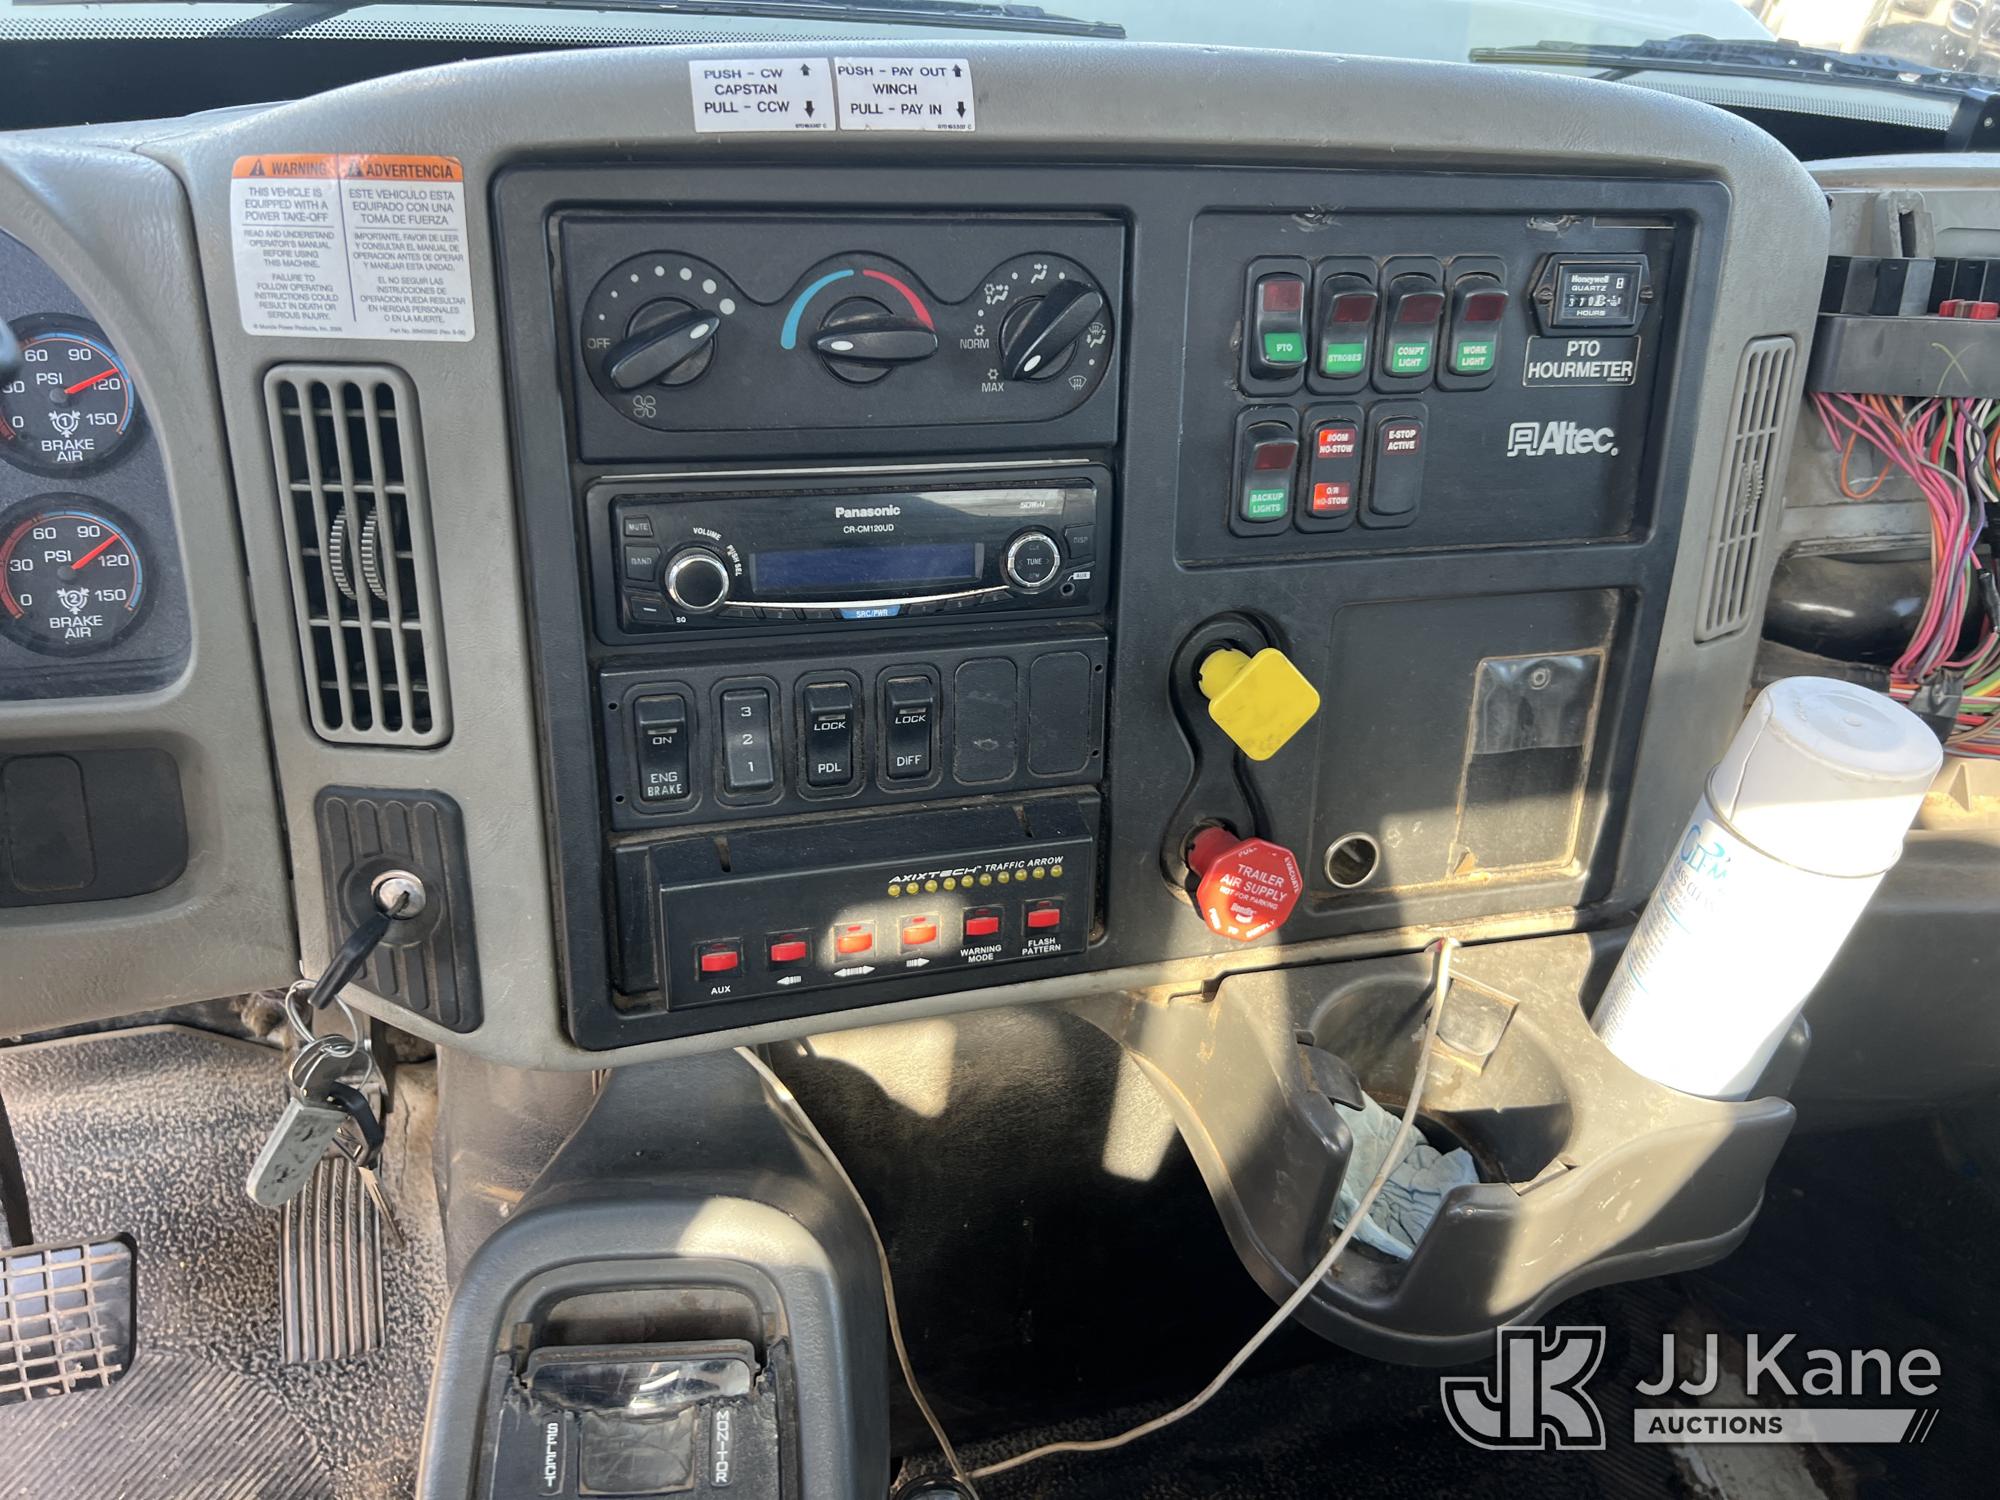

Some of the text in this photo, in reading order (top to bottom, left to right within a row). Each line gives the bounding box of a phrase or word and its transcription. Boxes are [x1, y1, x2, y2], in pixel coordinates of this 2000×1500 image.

[704, 69, 783, 79] PUSH CW
[838, 66, 947, 77] PUSH PAY OUT
[715, 84, 777, 95] CAPSTAN
[873, 84, 917, 94] WINCH
[704, 102, 790, 113] PULL CCW
[851, 104, 942, 114] PULL PAY IN
[272, 161, 327, 175] WARNING
[367, 164, 453, 178] ADVERTENCIA
[249, 187, 322, 197] THIS VEHICLE IS
[349, 189, 455, 200] ESTE VEHICULO ESTA
[245, 200, 328, 210] EQUIPPED WITH A
[353, 201, 454, 213] EQUIPADO CON UNA
[246, 211, 328, 222] POWER TAKE-OFF
[361, 213, 448, 225] TOMA DE FUERZA
[283, 231, 334, 239] UNDERSTAND
[264, 259, 281, 267] THIS
[304, 274, 315, 282] TO
[1572, 275, 1609, 284] Honeywell
[256, 282, 288, 290] FOLLOW
[587, 337, 611, 350] OFF
[960, 337, 990, 351] NORM
[1277, 343, 1293, 352] PTO
[1463, 345, 1487, 354] WORK
[1567, 340, 1600, 357] PTO
[25, 350, 48, 362] 60
[69, 349, 91, 361] 90
[1398, 347, 1424, 356] COMPT
[1398, 358, 1422, 367] LIGHT
[1462, 357, 1485, 366] LIGHT
[1528, 361, 1632, 379] HOURMETER
[37, 372, 63, 385] PSI
[981, 382, 1005, 393] MAX
[12, 416, 24, 429] 0
[86, 413, 118, 426] 150
[1327, 434, 1348, 442] BOOM
[1389, 430, 1416, 440] E-STOP
[42, 439, 94, 451] BRAKE
[1320, 444, 1353, 453] NO-STOW
[1388, 440, 1414, 450] ACTIVE
[57, 450, 83, 462] AIR
[1252, 492, 1283, 502] BACKUP
[835, 505, 901, 518] Panasonic
[1253, 503, 1280, 513] LIGHTS
[77, 526, 100, 538] 90
[629, 523, 648, 531] MUTE
[843, 523, 894, 534] CR-CM120UD
[33, 528, 56, 540] 60
[693, 527, 722, 540] VOLUME
[44, 550, 71, 563] PSI
[98, 554, 129, 567] 120
[10, 559, 33, 572] 30
[20, 594, 32, 606] 0
[95, 589, 127, 601] 150
[50, 615, 103, 628] BRAKE
[65, 627, 91, 639] AIR
[740, 706, 752, 718] 3
[894, 713, 926, 725] LOCK
[813, 720, 846, 732] LOCK
[653, 735, 673, 745] ON
[742, 734, 753, 745] 2
[747, 761, 755, 772] 1
[896, 755, 922, 767] DIFF
[817, 762, 842, 774] PDL
[651, 772, 678, 783] ENG
[647, 783, 683, 797] BRAKE
[984, 860, 1025, 873] TRAFFIC
[1027, 856, 1064, 867] ARROW
[1238, 864, 1284, 887] TRAILER
[1220, 873, 1287, 902] AIR SUPPLY
[1250, 896, 1278, 910] PARKING
[1022, 943, 1062, 955] PATTERN
[1027, 938, 1056, 948] FLASH
[960, 945, 1002, 958] WARNING
[968, 952, 994, 963] MODE
[711, 985, 731, 995] AUX
[716, 1410, 730, 1483] MONITOR
[544, 1422, 559, 1487] SELECT
